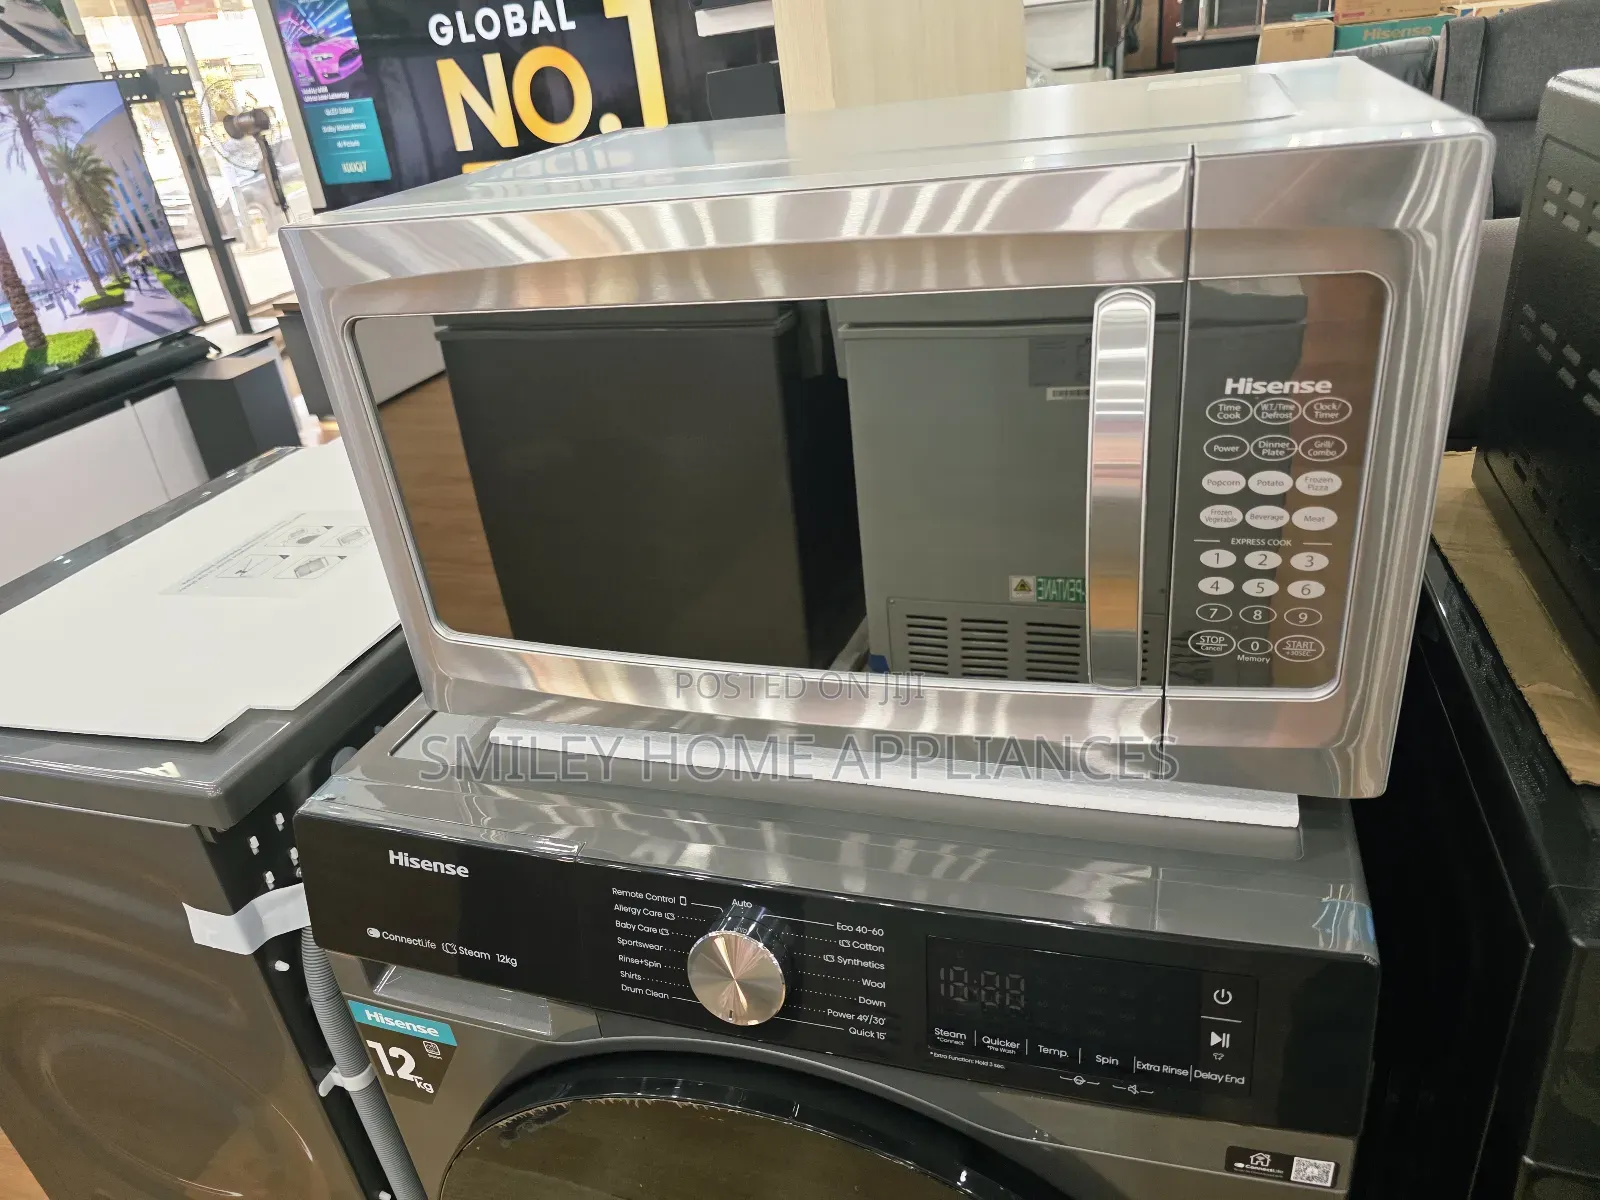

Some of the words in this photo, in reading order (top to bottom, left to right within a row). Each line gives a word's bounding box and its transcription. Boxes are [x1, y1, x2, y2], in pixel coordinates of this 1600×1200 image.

[428, 0, 577, 46] GLOBAL
[1363, 24, 1433, 42] Hisense
[1224, 377, 1333, 395] Hisense
[1218, 404, 1241, 412] Time
[1313, 402, 1342, 411] Clock/
[1216, 411, 1241, 420] Cook
[1261, 411, 1293, 420] Defrost
[1314, 411, 1340, 420] Timer
[1213, 445, 1240, 453] Power
[1258, 440, 1290, 449] Dinner
[1313, 440, 1335, 449] Grill/
[1261, 448, 1285, 457] Plate
[1307, 448, 1337, 457] Combo
[1207, 479, 1241, 489] Popcorn
[1256, 479, 1285, 487] Potato
[1304, 476, 1334, 484] Frozen
[1307, 483, 1329, 491] Pizza
[1210, 508, 1233, 516] Frozen
[1250, 513, 1285, 522] Beverage
[1205, 515, 1238, 524] Vegetable
[1303, 514, 1326, 523] Meat
[1231, 538, 1266, 546] EXPRESS
[1267, 538, 1293, 547] COOK
[1213, 552, 1220, 565] 1
[1257, 553, 1268, 566] 2
[1304, 555, 1315, 568] 3
[1209, 580, 1220, 592] 4
[1255, 582, 1265, 594] 5
[1301, 583, 1312, 596] 6
[1209, 608, 1218, 619] 7
[1253, 609, 1263, 621] 8
[1298, 612, 1308, 624] 9
[1199, 635, 1225, 644] STOP
[1285, 640, 1315, 649] START
[1200, 644, 1223, 652] Cancel
[1250, 641, 1260, 651] 0
[1237, 654, 1271, 664] Memory
[388, 849, 470, 878] Hisense
[611, 887, 644, 899] Remote
[645, 892, 676, 904] Control
[731, 898, 753, 909] Auto
[614, 903, 641, 916] Allergy
[642, 908, 663, 918] Care
[615, 919, 636, 932] Baby
[637, 924, 658, 934] Care
[836, 922, 854, 932] Eco
[855, 926, 885, 937] 40-60
[381, 931, 437, 950] ConnectLife
[458, 945, 491, 961] Steam
[495, 952, 518, 968] 12kg
[617, 936, 664, 952] Sportswear
[852, 940, 885, 953] Cotton
[618, 954, 662, 969] Rinse+Spin
[837, 955, 885, 970] Synthetics
[620, 970, 642, 981] Shirts
[861, 978, 886, 989] Wool
[621, 983, 644, 995] Drum
[645, 988, 670, 999] Clean
[858, 996, 886, 1008] Down
[827, 1008, 855, 1020] Power
[364, 1009, 440, 1037] Hisense
[848, 1026, 876, 1039] Quick
[934, 1027, 967, 1040] Steam
[982, 1035, 1021, 1049] Quicker
[1037, 1044, 1070, 1058] Temp.
[1095, 1054, 1119, 1066] Spin
[1136, 1061, 1161, 1073] Extra
[1162, 1064, 1189, 1077] Rinse
[1194, 1069, 1224, 1084] Delay
[1224, 1074, 1246, 1085] End
